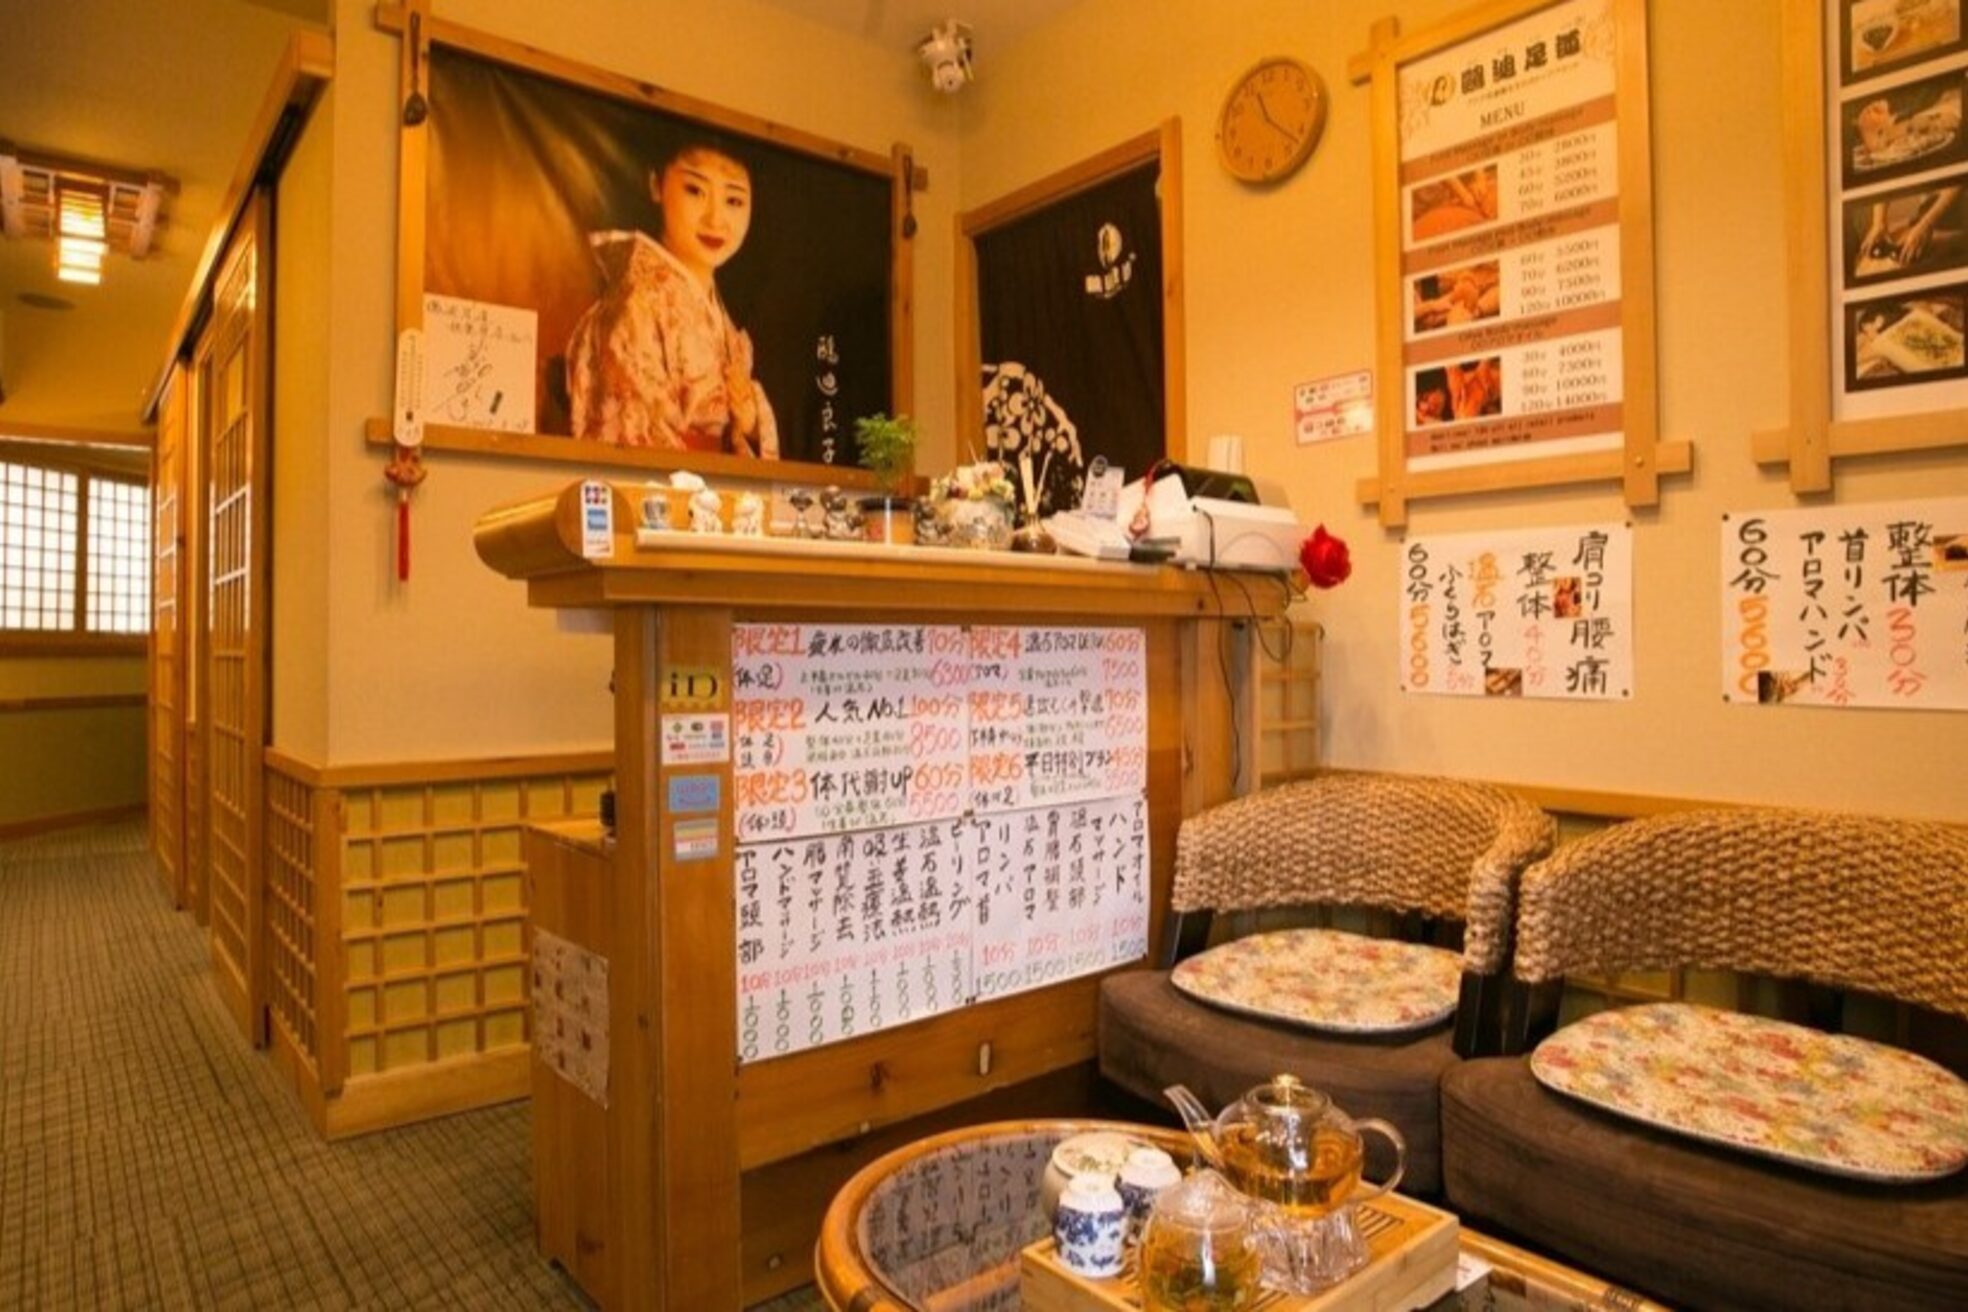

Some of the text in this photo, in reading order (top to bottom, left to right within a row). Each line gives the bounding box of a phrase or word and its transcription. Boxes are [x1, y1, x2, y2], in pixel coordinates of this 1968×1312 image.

[1480, 102, 1525, 129] MENU
[1516, 551, 1557, 620] 整体
[1730, 518, 1781, 594] 60分
[1838, 527, 1870, 641] 首リンパ
[1881, 521, 1937, 608] 整体
[1565, 530, 1614, 694] 肩コリ腰痛
[1799, 530, 1833, 684] アロマハンド
